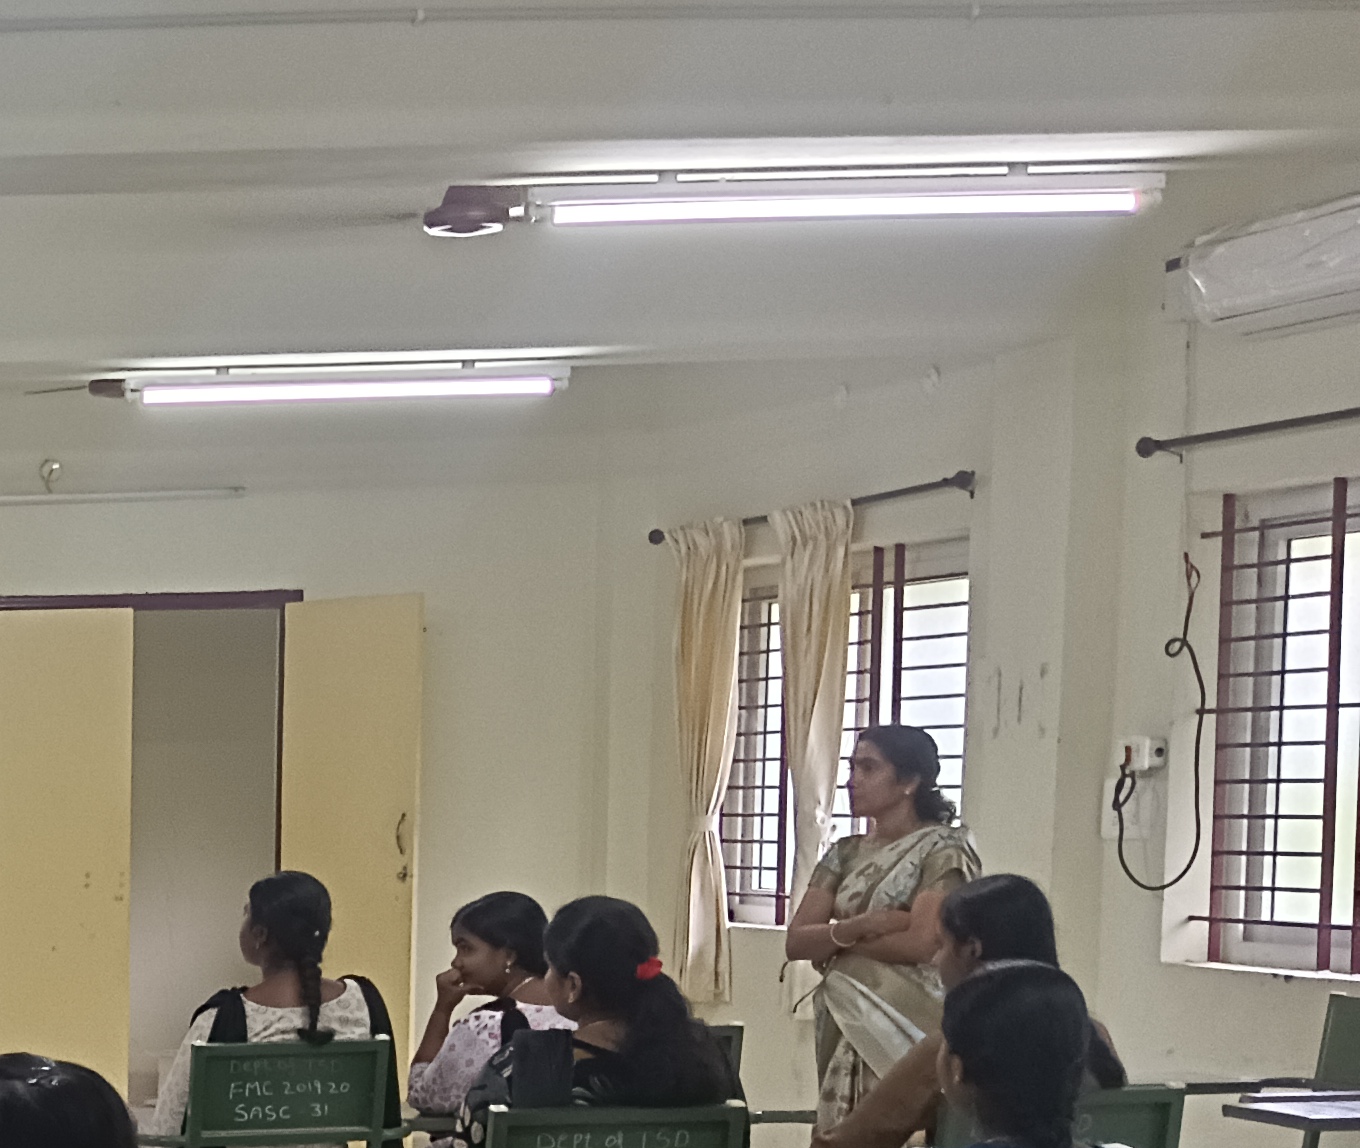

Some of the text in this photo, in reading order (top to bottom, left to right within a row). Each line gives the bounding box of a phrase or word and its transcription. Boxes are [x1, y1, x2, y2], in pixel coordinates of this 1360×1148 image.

[230, 1081, 274, 1100] FMC
[233, 1103, 329, 1122] SASC 31
